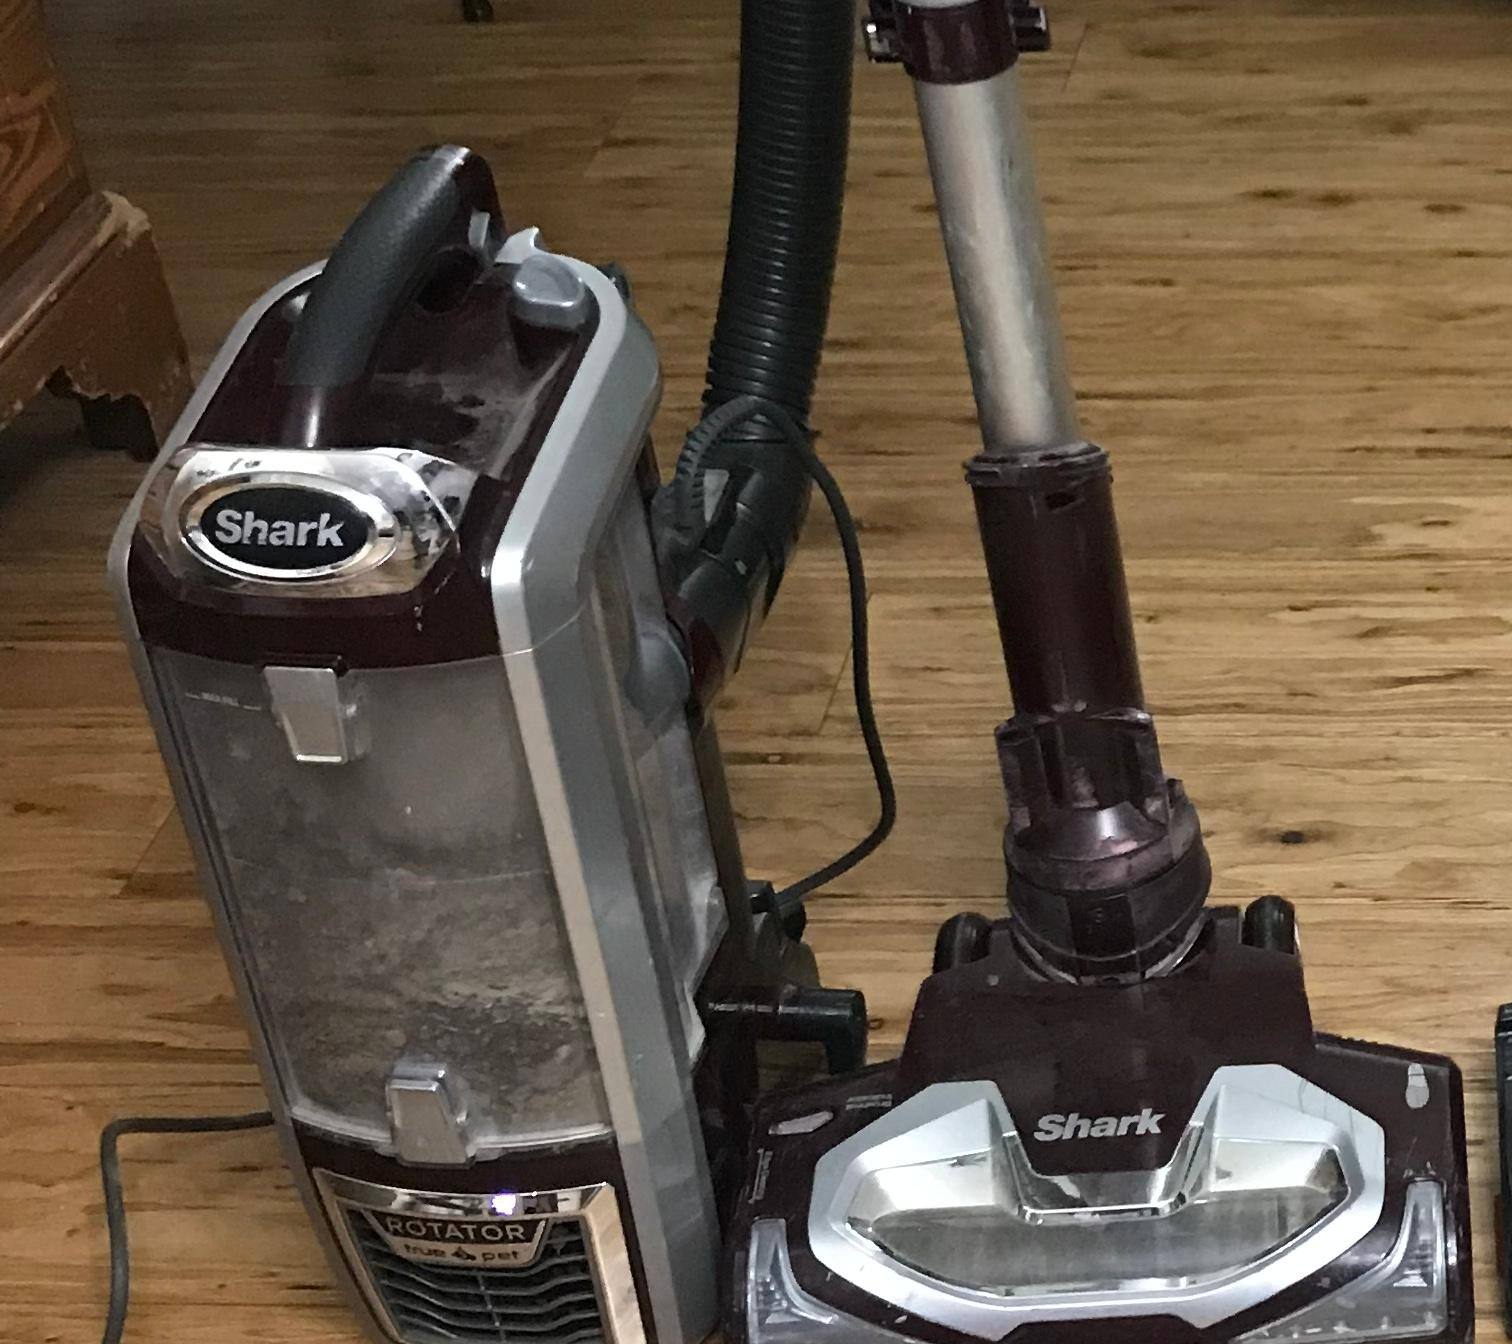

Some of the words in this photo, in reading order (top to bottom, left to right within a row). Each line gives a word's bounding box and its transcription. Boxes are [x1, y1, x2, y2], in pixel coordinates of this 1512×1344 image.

[215, 509, 345, 547] Shark
[1033, 1108, 1167, 1141] Shark
[385, 1216, 526, 1241] ROTATOR
[404, 1244, 446, 1256] true
[481, 1250, 519, 1262] pet
